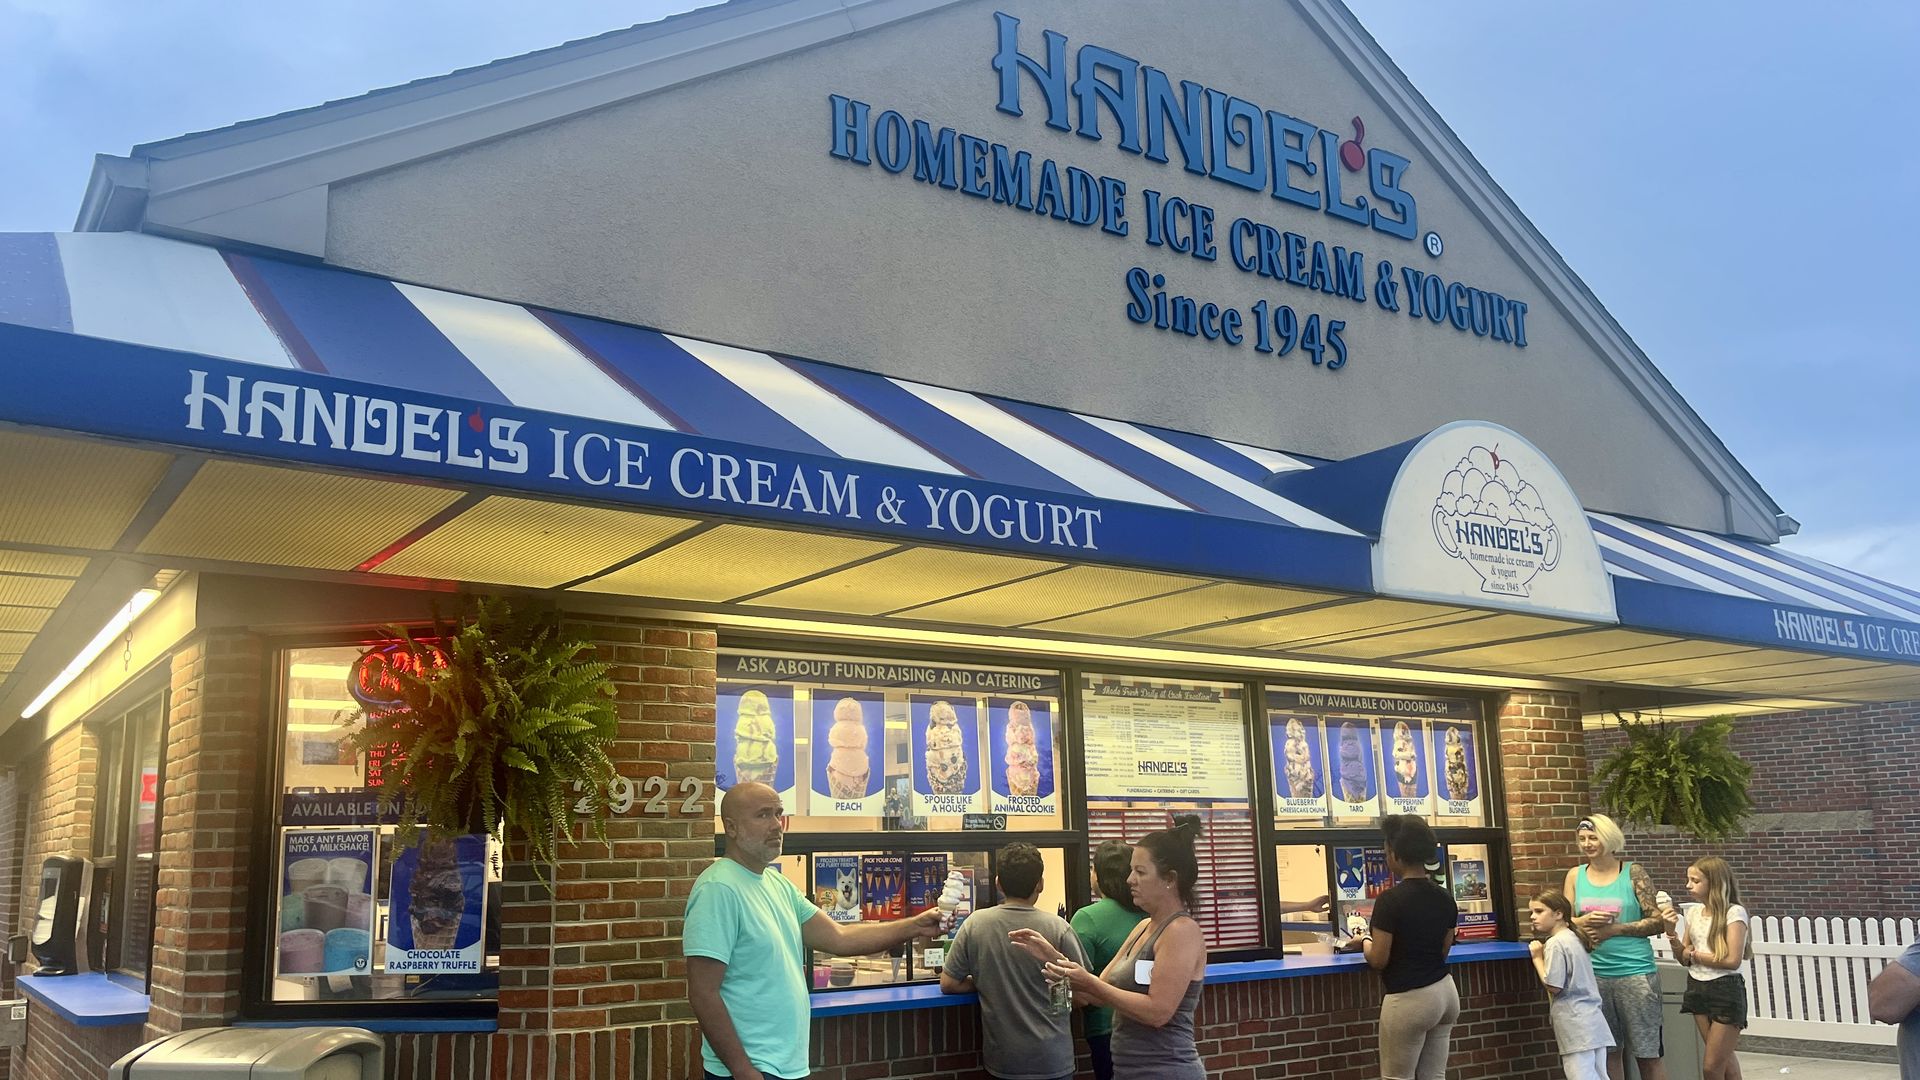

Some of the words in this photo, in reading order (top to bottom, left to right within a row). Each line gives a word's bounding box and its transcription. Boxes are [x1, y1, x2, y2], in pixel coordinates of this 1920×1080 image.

[993, 11, 1418, 240] HANDEL'S
[830, 94, 1128, 236] HOMEMADE
[1145, 190, 1217, 261] ICE
[1230, 217, 1366, 302] CREAM
[1376, 259, 1400, 313] &
[1400, 266, 1528, 348] YOGURT
[1126, 266, 1244, 345] Since
[1252, 299, 1348, 370] 1945
[184, 369, 529, 474] HANDEL'S
[548, 427, 652, 491] ICE
[670, 447, 861, 519] CREAM
[876, 486, 907, 525] &
[918, 484, 1101, 550] YOGURT
[1455, 520, 1544, 555] HANDEL'S
[1470, 548, 1505, 565] homemade
[1506, 555, 1515, 566] ice
[1516, 559, 1535, 569] cream
[1491, 565, 1496, 576] &
[1497, 568, 1517, 580] yogurt
[1491, 581, 1505, 591] since
[1506, 582, 1519, 592] 1945
[1773, 609, 1858, 648] HANDEL'S
[1859, 623, 1889, 652] ICE
[737, 657, 769, 673] ASK
[775, 660, 830, 676] ABOUT
[835, 663, 936, 683] FUNDRAISING
[941, 670, 972, 685] AND
[976, 673, 1041, 689] CATERING
[1299, 694, 1323, 706] NOW
[1327, 696, 1377, 710] AVAILABLE
[1380, 699, 1394, 711] ON
[1397, 700, 1448, 714] DOORDASH
[1138, 761, 1187, 773] HANDEL'S
[368, 779, 384, 787] SUN
[835, 802, 862, 811] PEACH
[924, 796, 955, 804] SPOUSE
[956, 796, 972, 804] LIKE
[1008, 796, 1040, 805] FROSTED
[292, 802, 371, 816] AVAILABLE
[994, 804, 1025, 813] ANIMAL
[1026, 804, 1054, 813] COOKIE
[290, 835, 314, 844] MAKE
[316, 834, 335, 843] ANY
[336, 834, 369, 842] FLAVOR
[289, 844, 309, 853] INTO
[311, 844, 318, 852] A
[320, 843, 369, 852] MILKSHAKE!
[407, 950, 460, 959] CHOCOLATE
[390, 961, 439, 970] RASPBERRY
[441, 961, 477, 970] TRUFFLE
